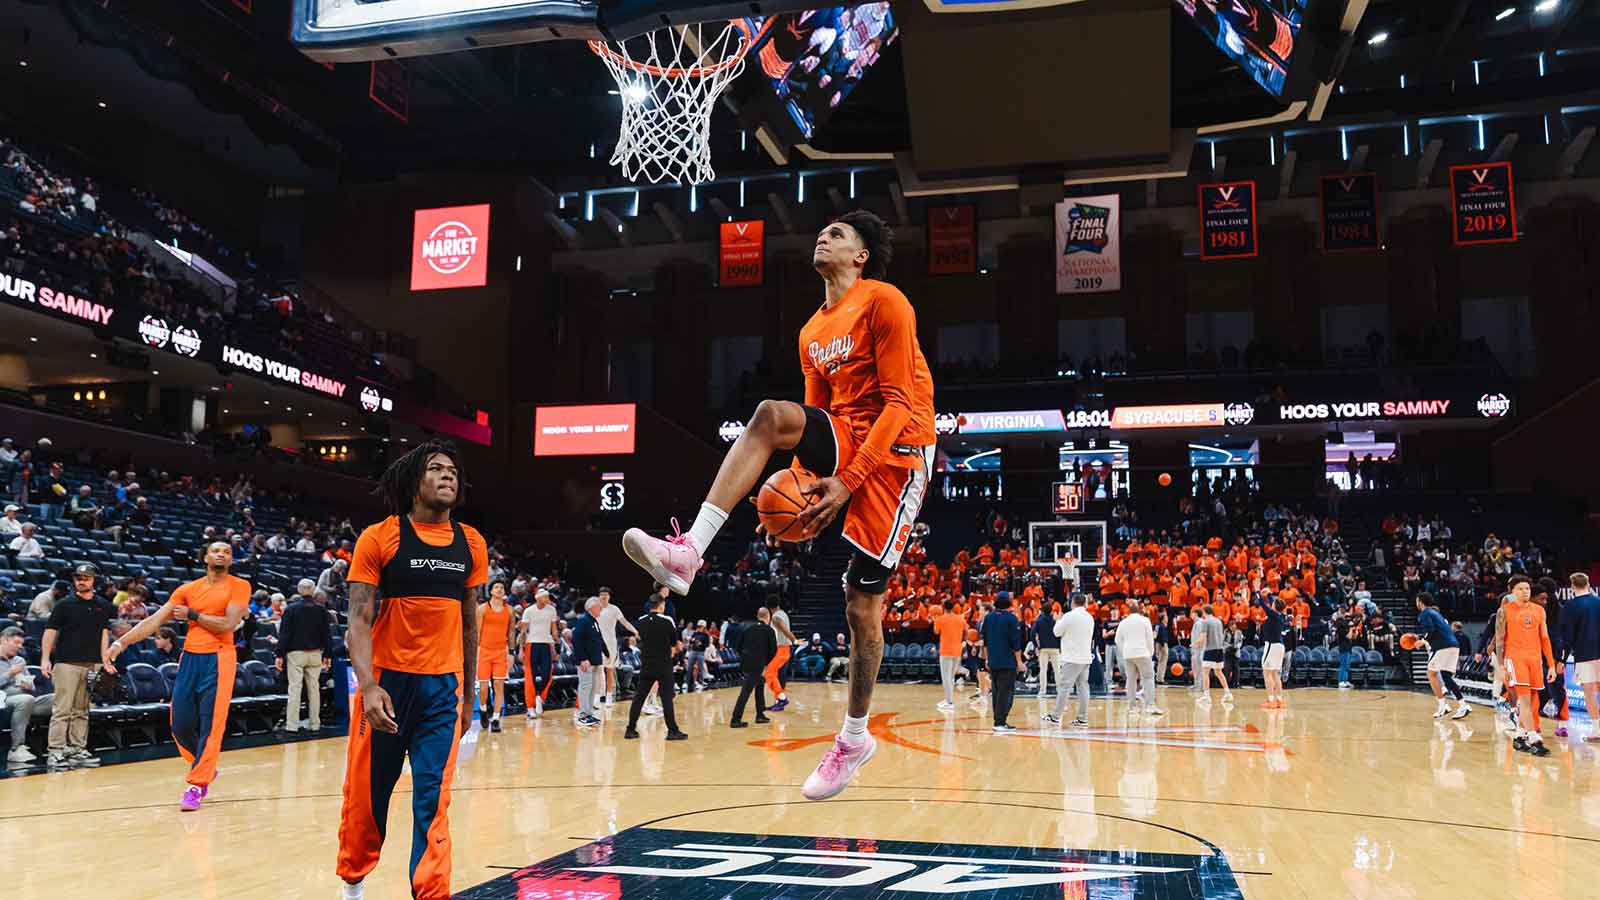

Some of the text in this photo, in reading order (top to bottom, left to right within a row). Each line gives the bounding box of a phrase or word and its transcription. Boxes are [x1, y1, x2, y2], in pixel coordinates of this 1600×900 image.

[1460, 201, 1506, 213] FINAL FOUR
[1073, 217, 1105, 230] FINAL
[1206, 218, 1248, 228] FINAL FOUR
[1463, 214, 1506, 232] 2019
[1070, 229, 1103, 241] FOUR
[1211, 230, 1246, 248] 1981
[422, 237, 478, 257] MARKET
[1063, 256, 1111, 268] NATIONAL
[1073, 278, 1103, 289] 2019
[38, 286, 113, 325] SAMMY
[808, 335, 855, 369] Poetry
[223, 345, 346, 397] HOOS YOUR SAMMY
[1280, 400, 1450, 419] HOOS YOUR SAMMY
[1477, 399, 1510, 411] MARKET
[980, 415, 1044, 428] VIRGINIA
[1067, 410, 1111, 427] 18:01
[1126, 409, 1202, 424] SYRACUSE
[1058, 494, 1079, 510] 30
[410, 558, 465, 570] STATSports
[562, 842, 1195, 894] ACC
